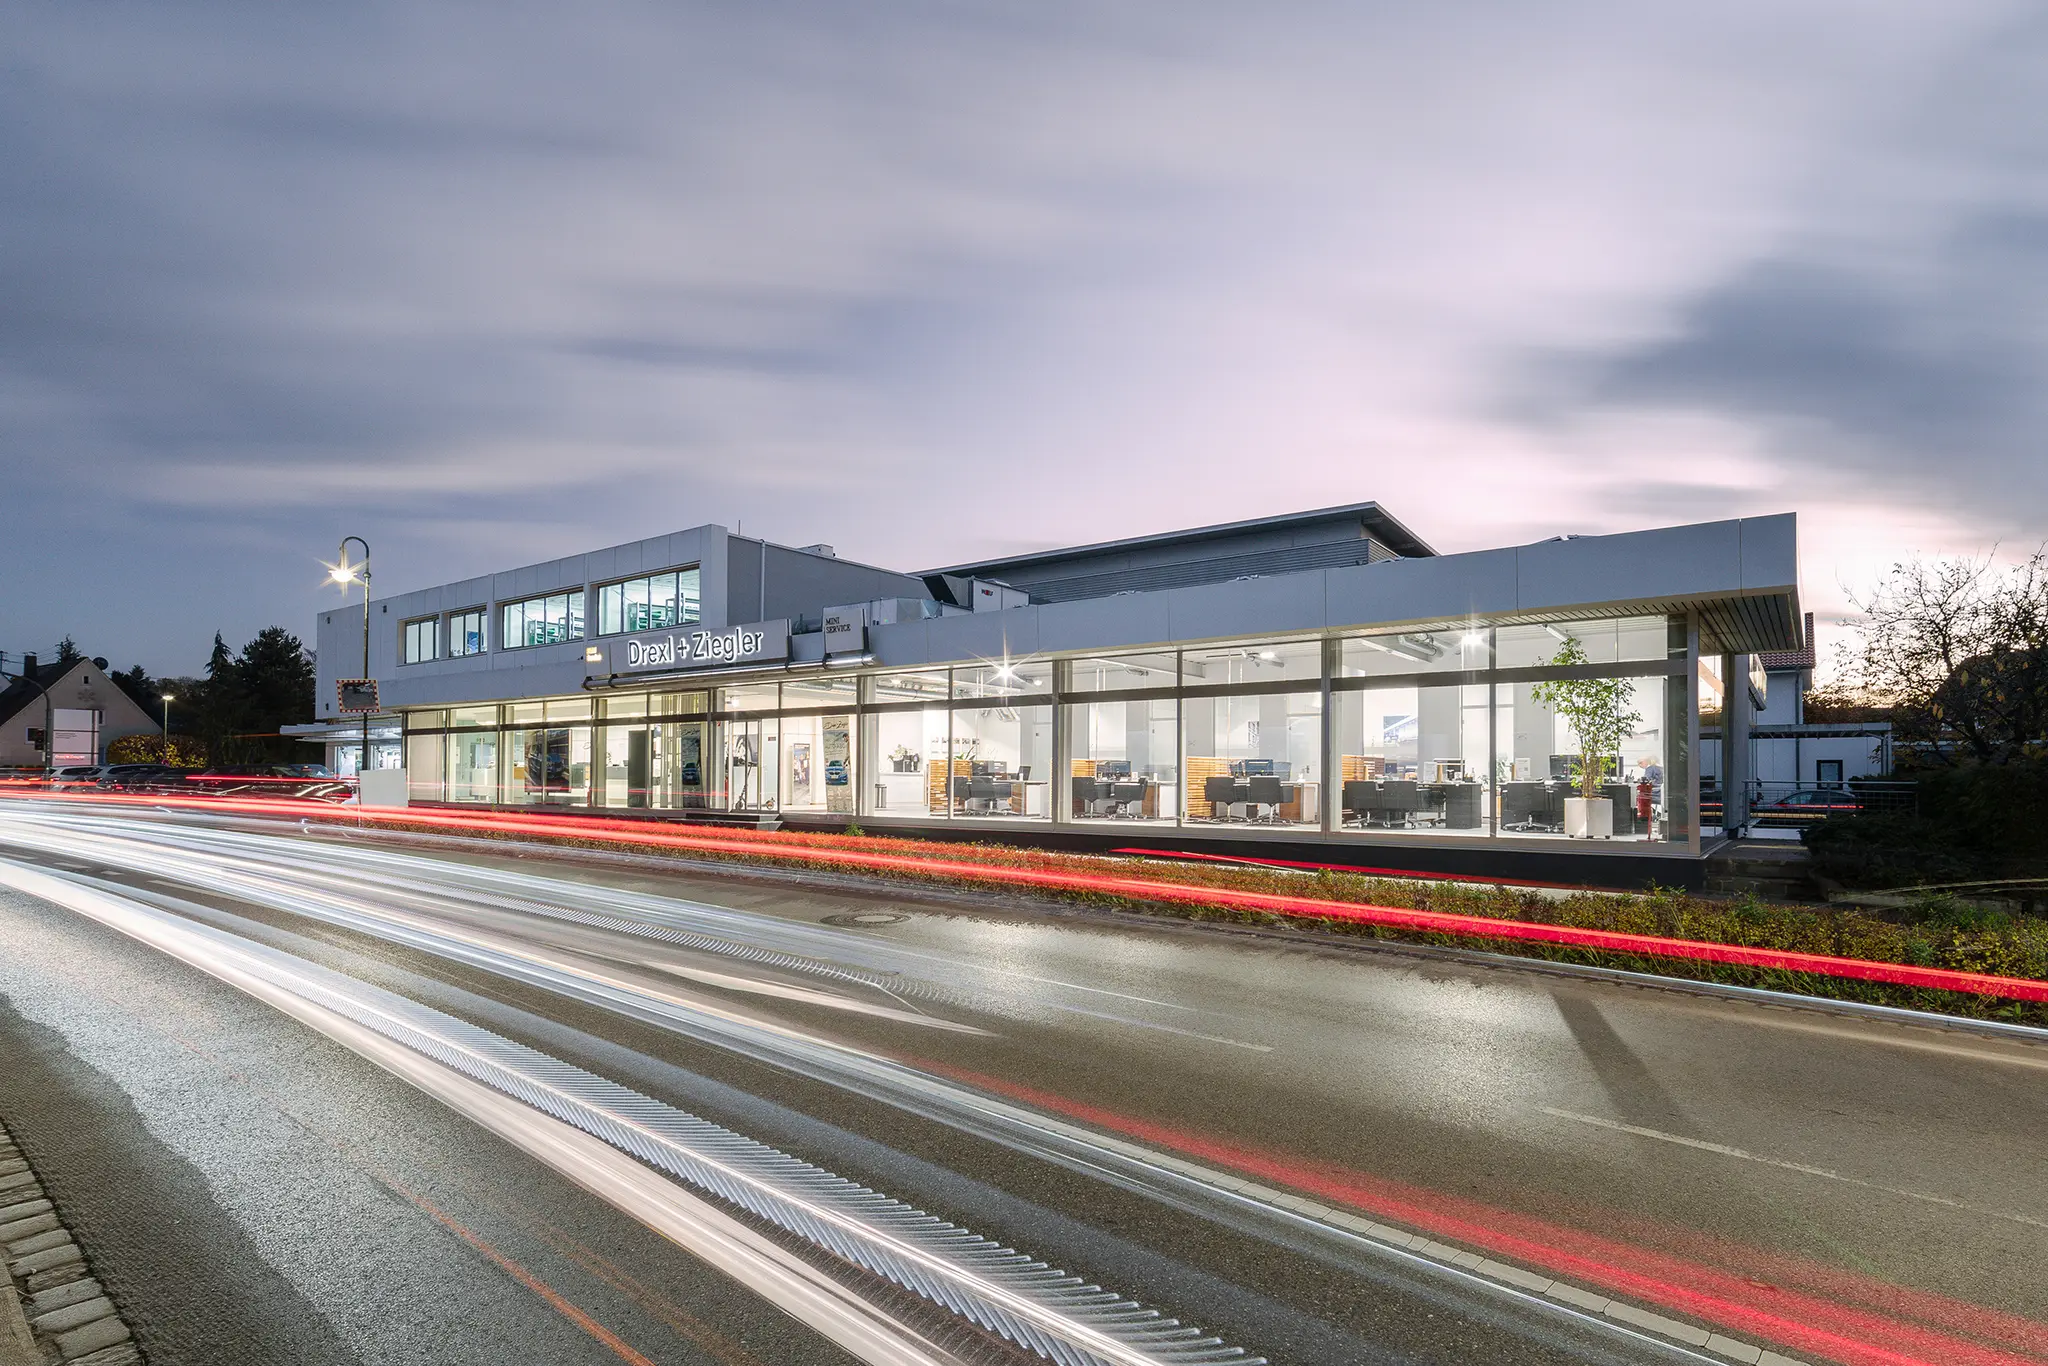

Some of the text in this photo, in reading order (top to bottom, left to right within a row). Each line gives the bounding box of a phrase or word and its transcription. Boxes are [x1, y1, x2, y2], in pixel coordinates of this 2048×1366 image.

[825, 616, 840, 625] MINI
[825, 623, 851, 634] SERVICE
[628, 636, 673, 666] Drexl
[692, 627, 764, 664] Ziegler
